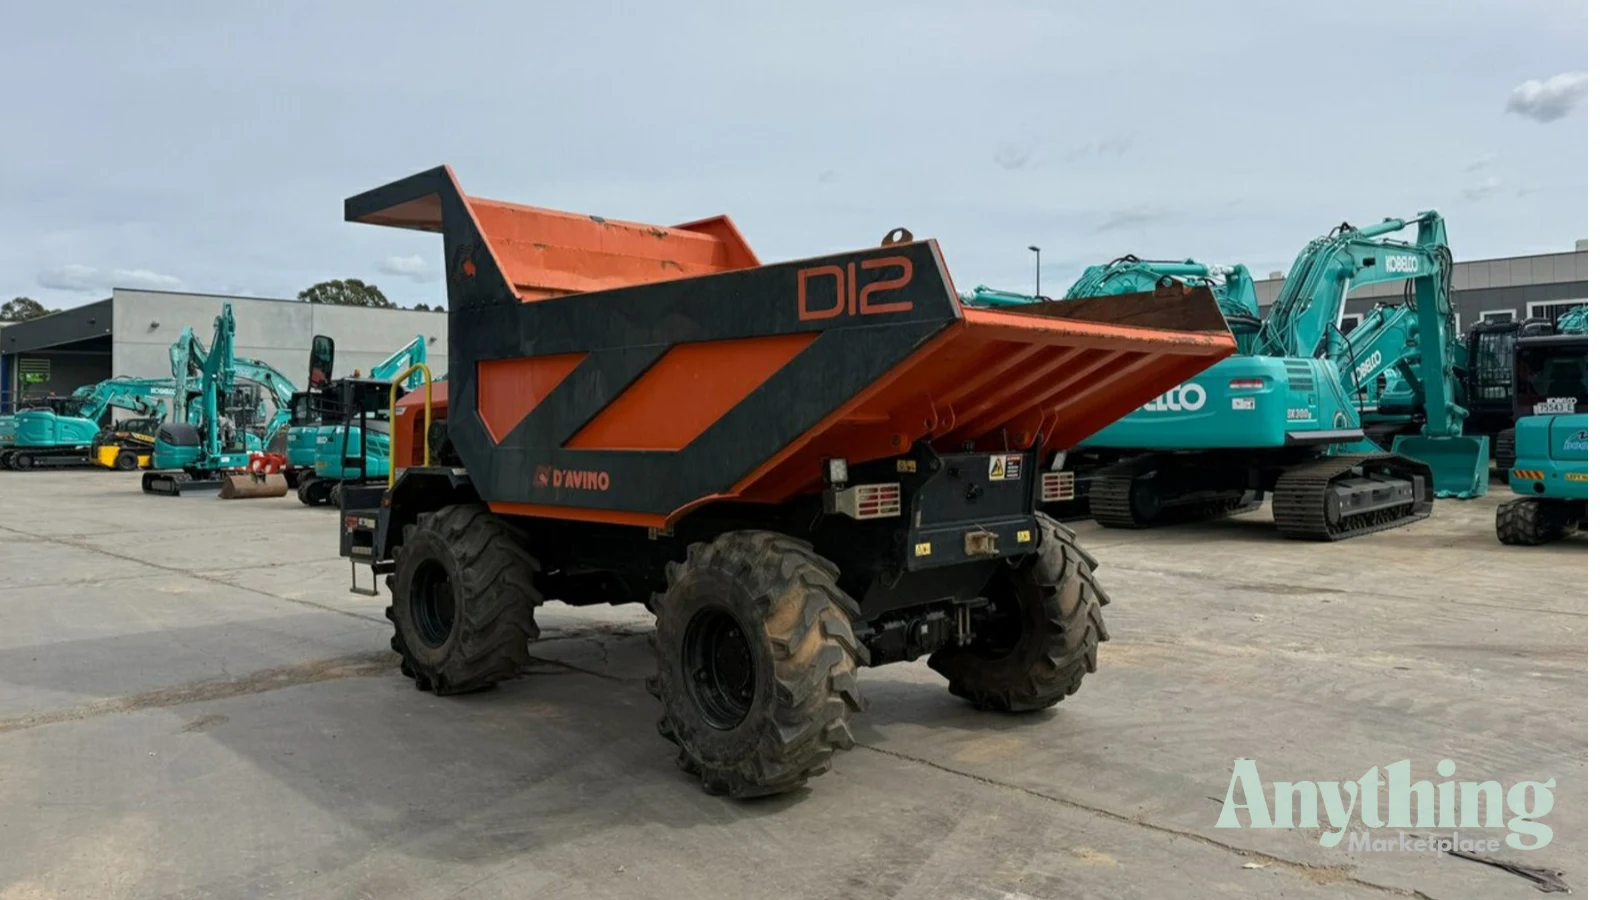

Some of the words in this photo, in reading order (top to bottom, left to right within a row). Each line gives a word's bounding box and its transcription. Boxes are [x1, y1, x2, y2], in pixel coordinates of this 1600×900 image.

[1385, 255, 1418, 273] KOBELCO
[797, 255, 913, 322] D12
[552, 469, 610, 491] D'AVINO
